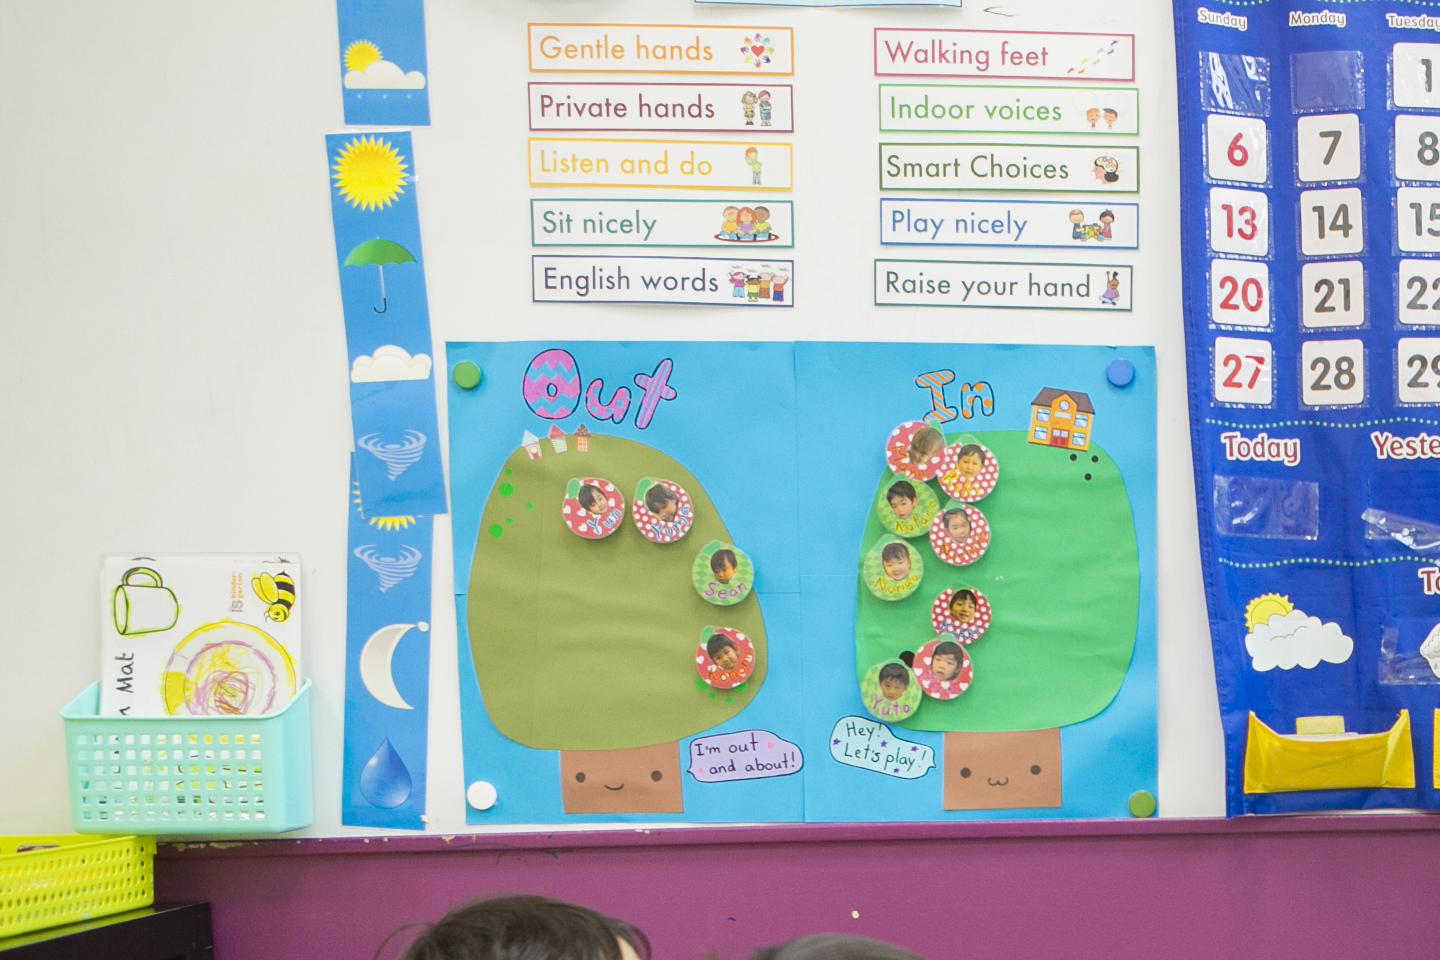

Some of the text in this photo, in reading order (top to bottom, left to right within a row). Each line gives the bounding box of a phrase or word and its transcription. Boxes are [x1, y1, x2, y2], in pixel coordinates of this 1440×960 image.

[1199, 9, 1247, 30] Sunday
[1289, 11, 1346, 28] Monday
[539, 34, 713, 61] Gentle hands
[884, 39, 1049, 72] Walking feet
[1420, 58, 1433, 93] 1
[540, 93, 715, 119] Private hands
[891, 95, 1062, 122] Indoor voices
[540, 149, 713, 176] Listen and do
[1226, 132, 1249, 168] 6
[1319, 130, 1343, 166] 7
[1417, 130, 1440, 167] 8
[886, 153, 1069, 180] Smart Choices
[542, 209, 657, 242] Sit nicely
[891, 209, 1028, 242] Play nicely
[1220, 203, 1258, 241] 13
[1311, 203, 1354, 240] 14
[544, 265, 719, 298] English words
[886, 270, 1090, 302] Raise your hand
[1219, 275, 1264, 313] 20
[1313, 277, 1351, 314] 21
[1222, 353, 1266, 390] 27
[1310, 355, 1356, 392] 28
[522, 347, 678, 431] Out
[915, 368, 996, 425] In
[1223, 433, 1299, 465] Today
[586, 509, 622, 534] Yun
[651, 505, 690, 540] Yuma
[895, 501, 937, 532] Kotaro
[704, 582, 748, 600] Sean
[874, 575, 919, 594] Nanao
[115, 652, 135, 693] Mat
[872, 693, 910, 716] Yuto
[694, 733, 759, 756] I'm out
[846, 722, 882, 741] Hey!
[709, 752, 796, 774] and about!
[844, 744, 880, 763] Let's
